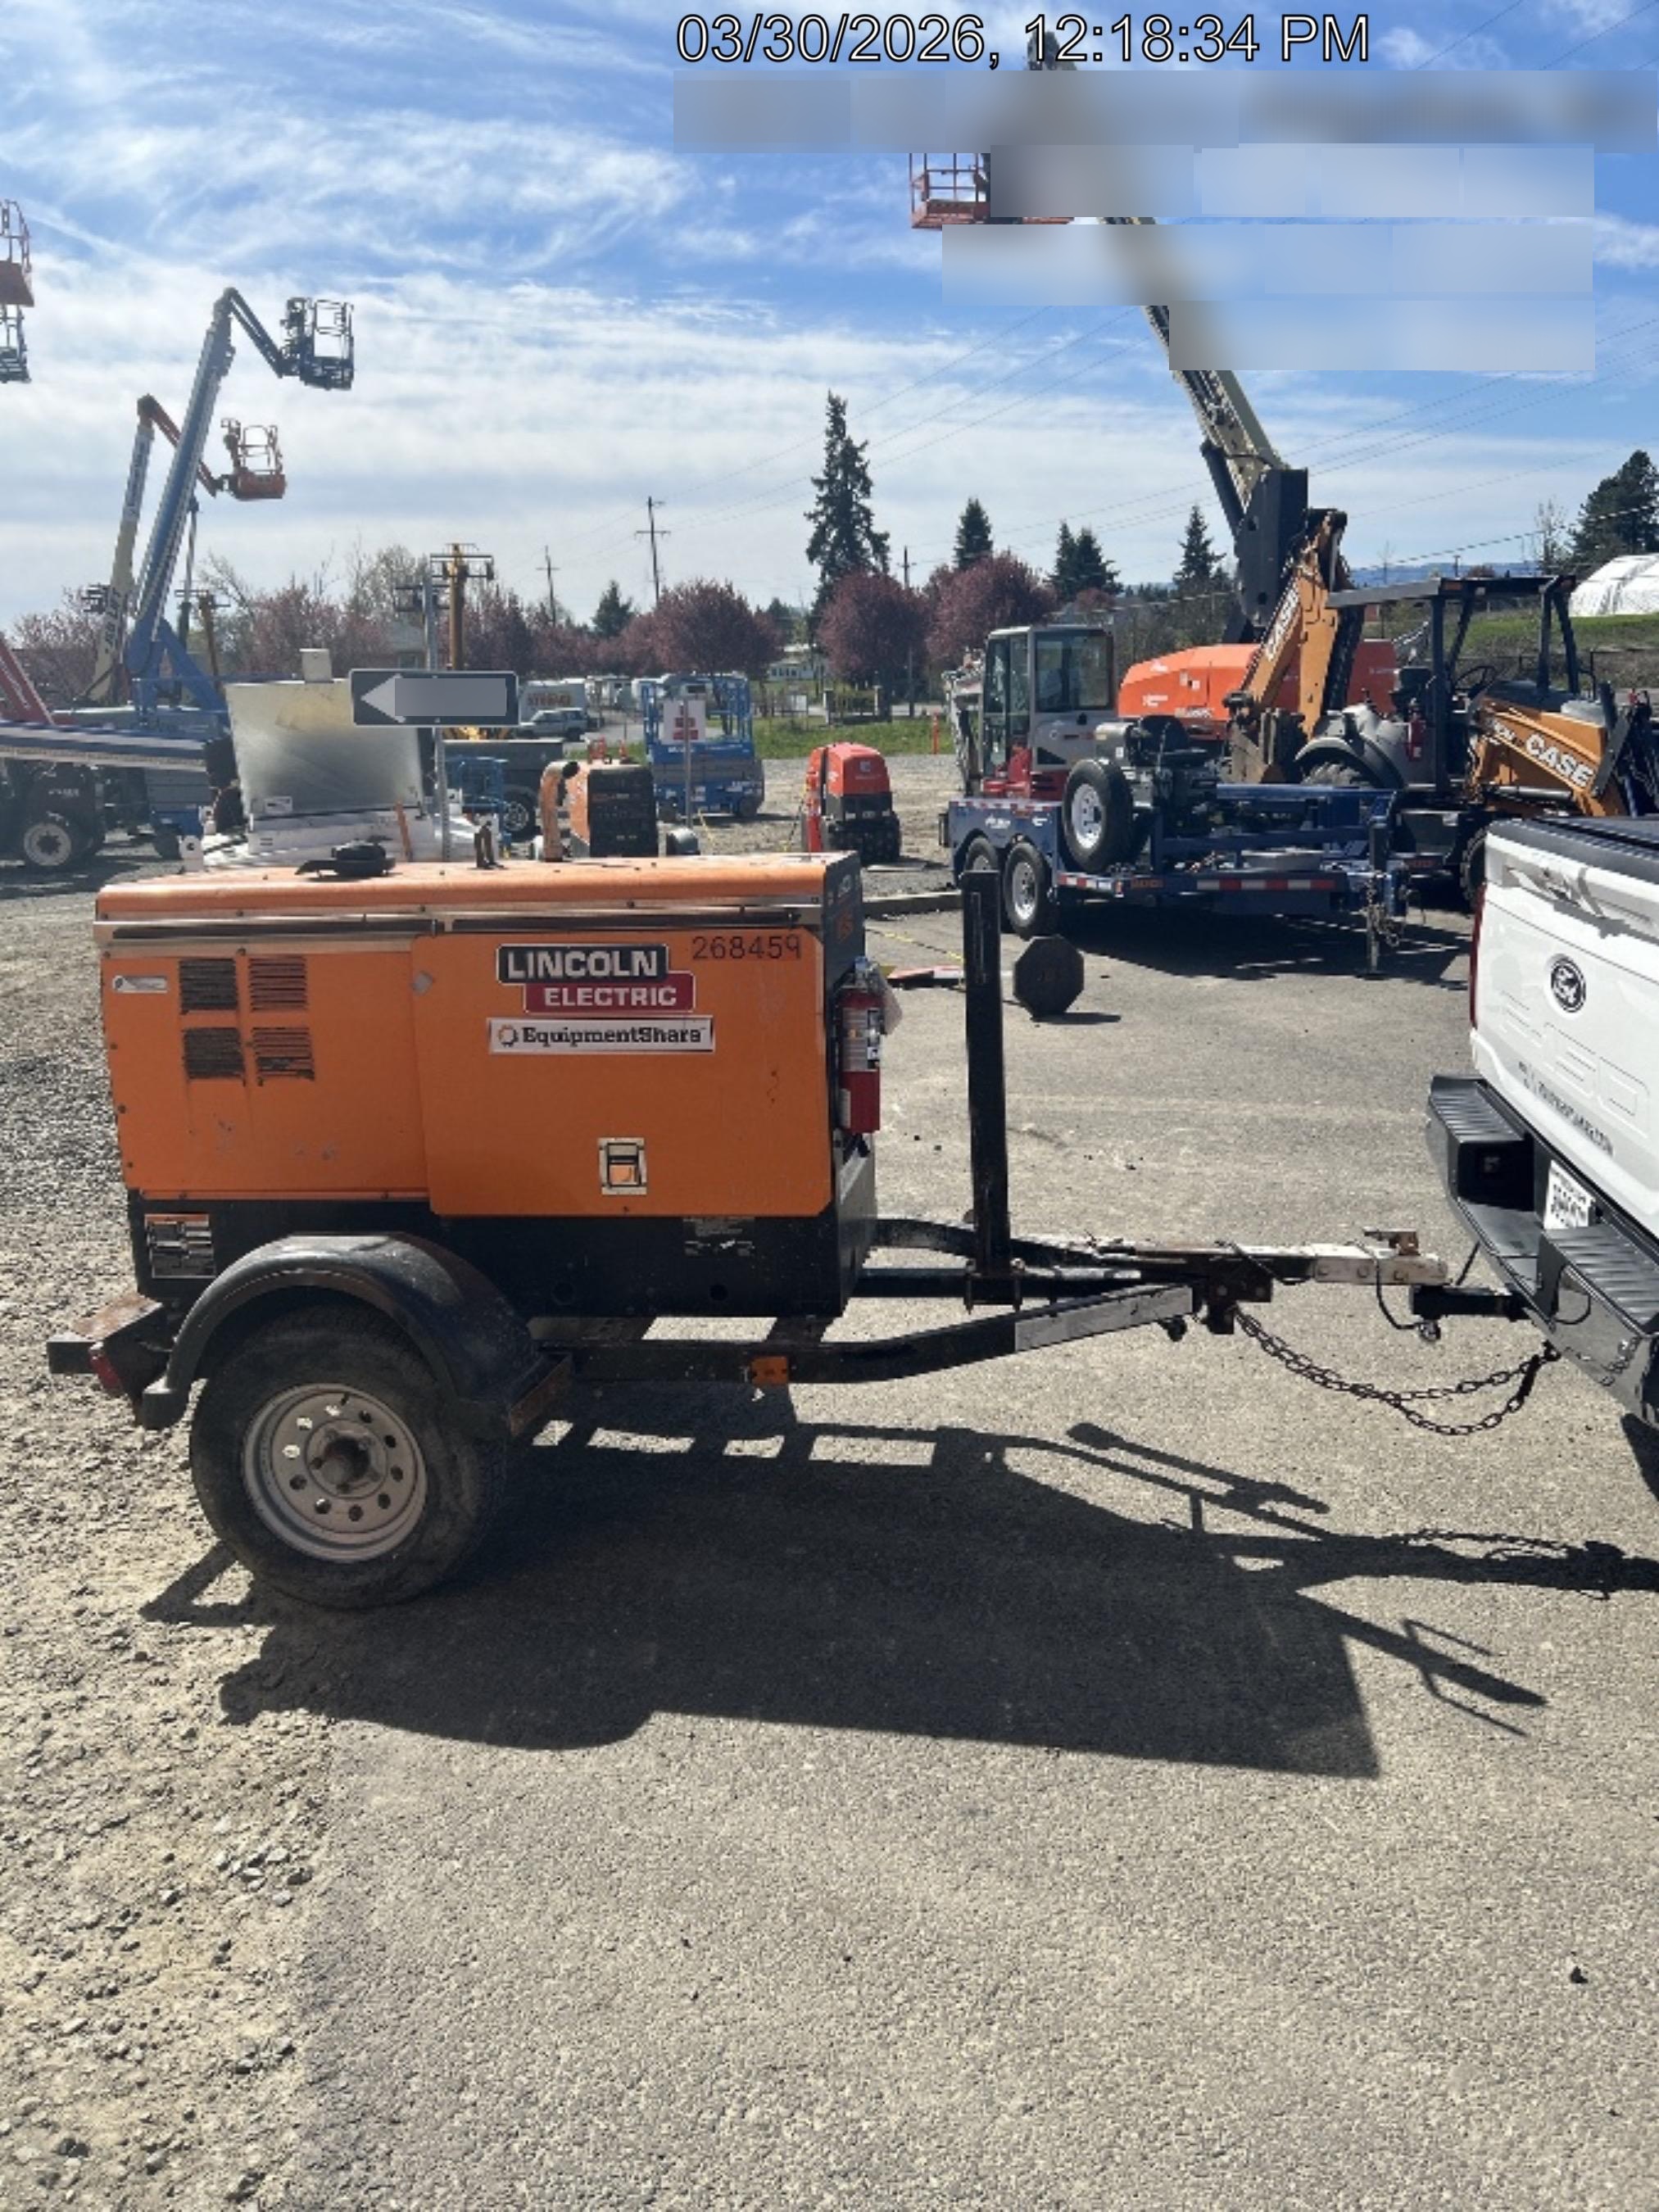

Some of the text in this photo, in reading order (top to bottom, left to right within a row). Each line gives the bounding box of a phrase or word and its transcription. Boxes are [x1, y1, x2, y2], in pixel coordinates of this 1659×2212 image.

[1264, 588, 1299, 663] CASE
[1525, 733, 1594, 787] CASE
[692, 936, 801, 959] 268459
[506, 950, 659, 978] LINCOLN
[544, 986, 677, 1007] ELECTRIC
[523, 1027, 702, 1047] EquipmentShare
